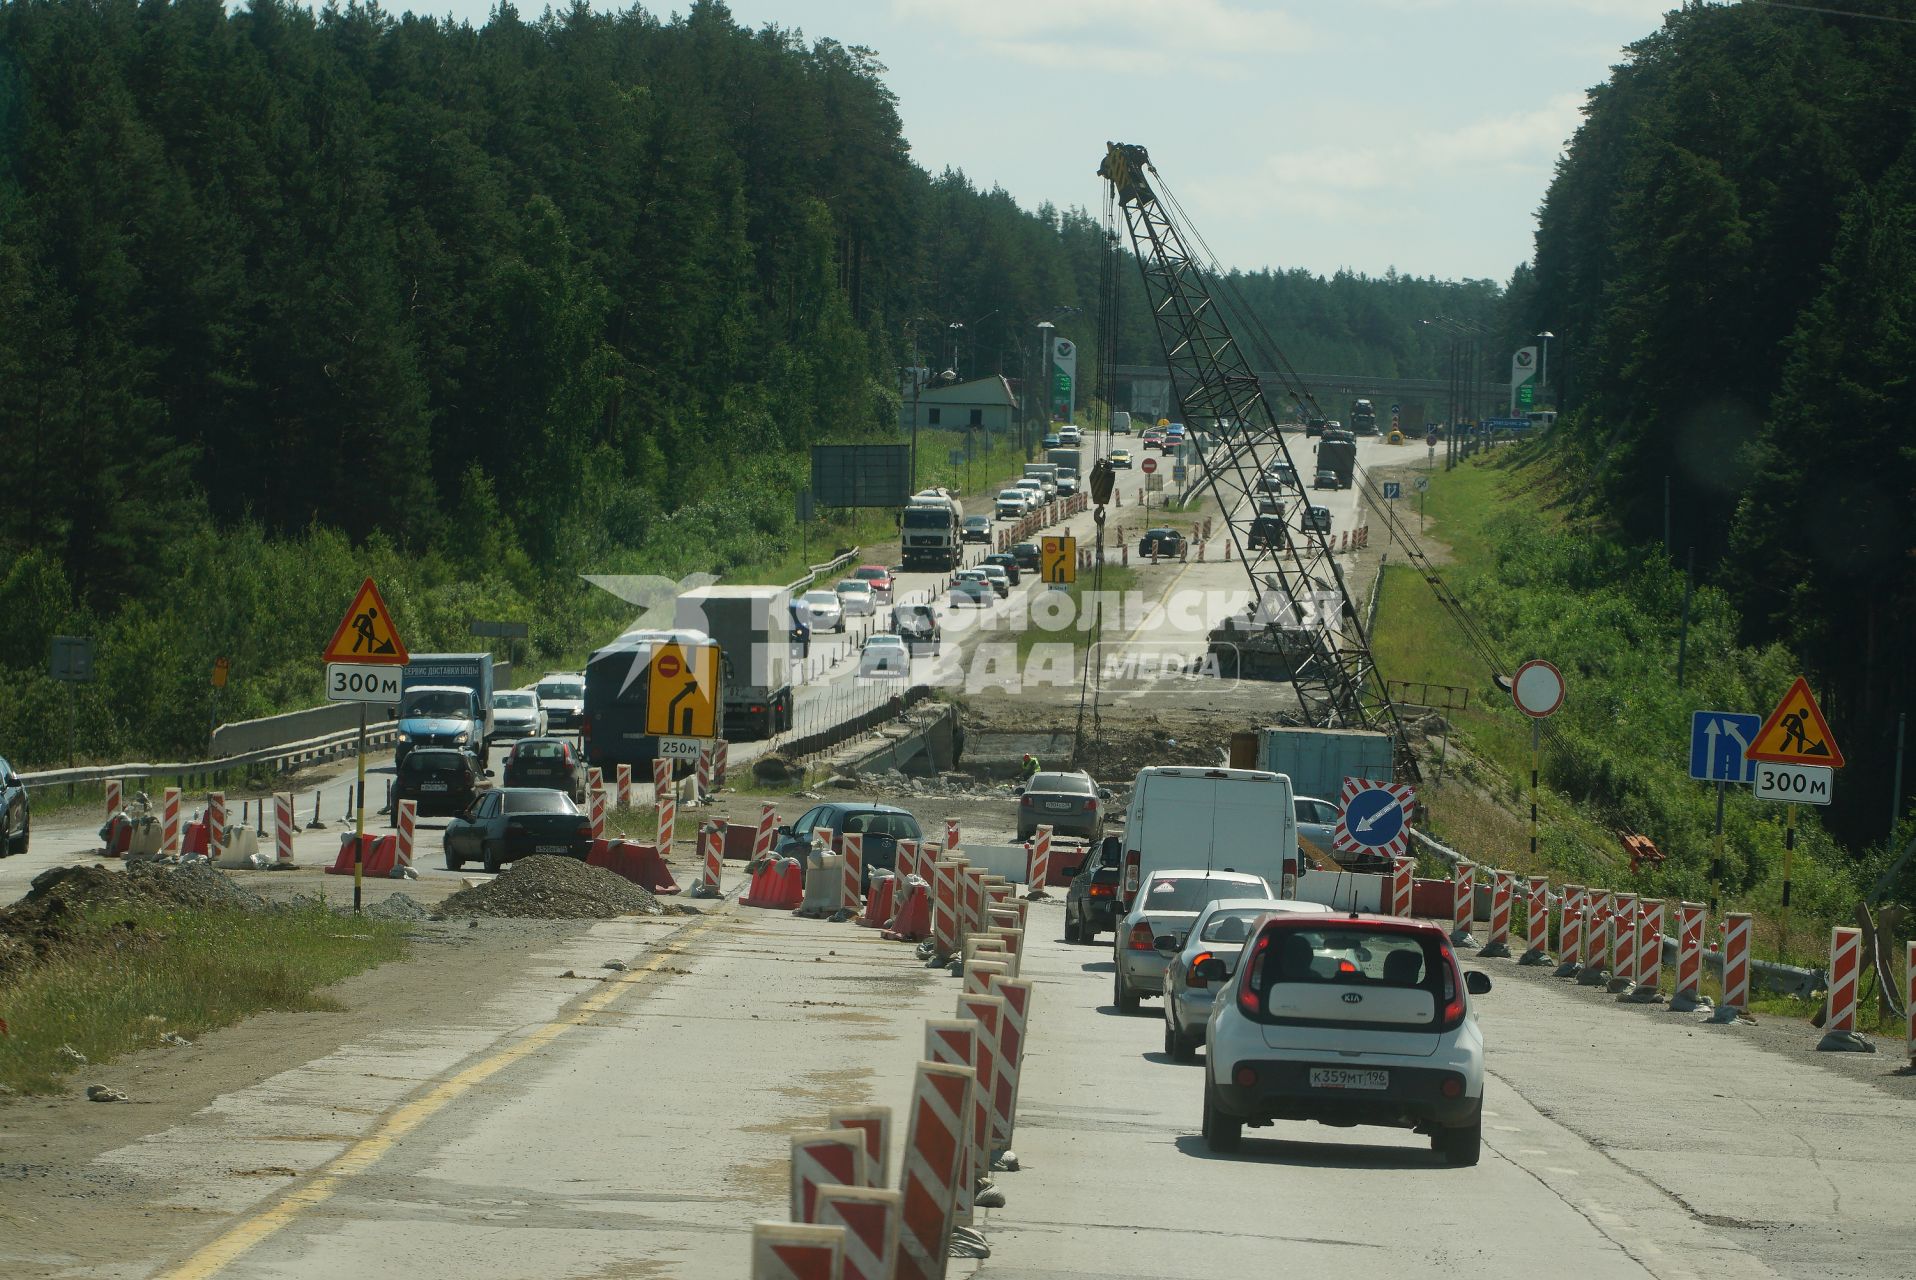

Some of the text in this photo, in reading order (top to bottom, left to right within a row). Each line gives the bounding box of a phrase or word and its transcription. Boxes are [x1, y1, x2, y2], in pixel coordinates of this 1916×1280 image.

[427, 666, 460, 676] ДОСТАВКИ
[1343, 993, 1361, 1003] KIA
[1366, 1072, 1386, 1082] 196
